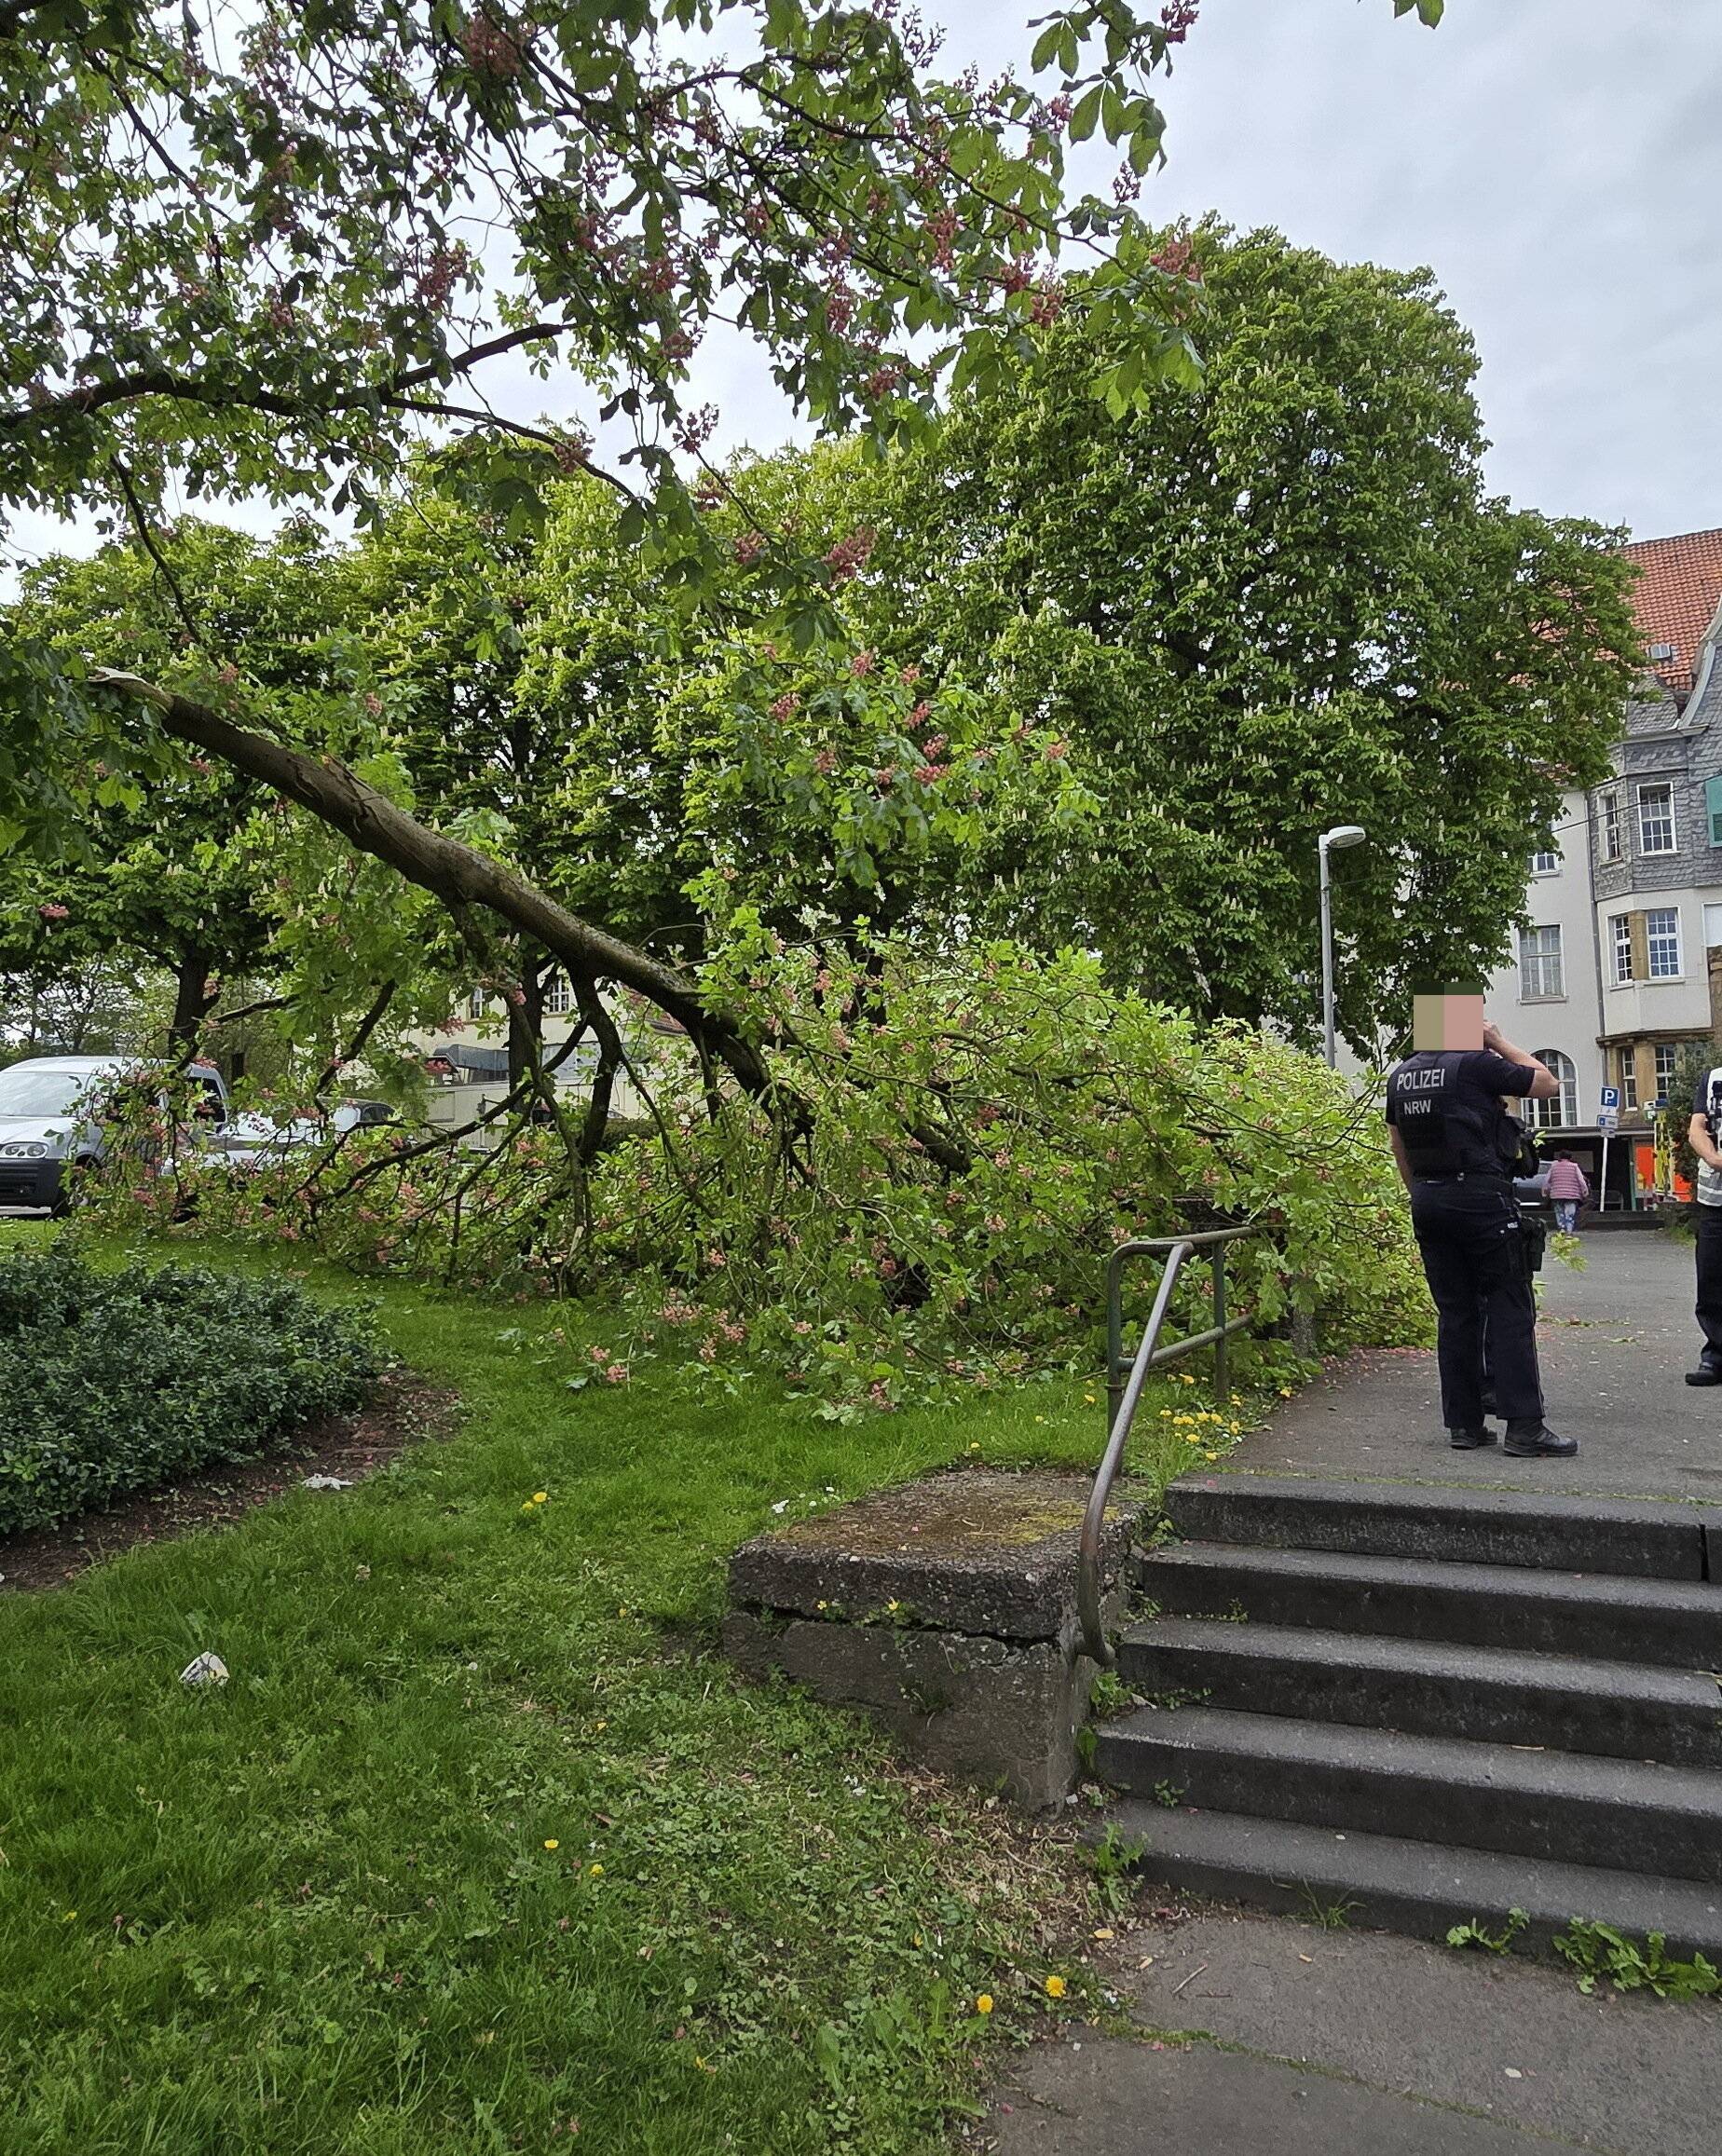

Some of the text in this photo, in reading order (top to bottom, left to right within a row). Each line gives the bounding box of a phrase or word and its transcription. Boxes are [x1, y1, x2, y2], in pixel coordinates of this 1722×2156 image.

[1397, 1069, 1445, 1091] POLIZEI
[1605, 1090, 1615, 1104] P
[1403, 1099, 1431, 1114] NRW
